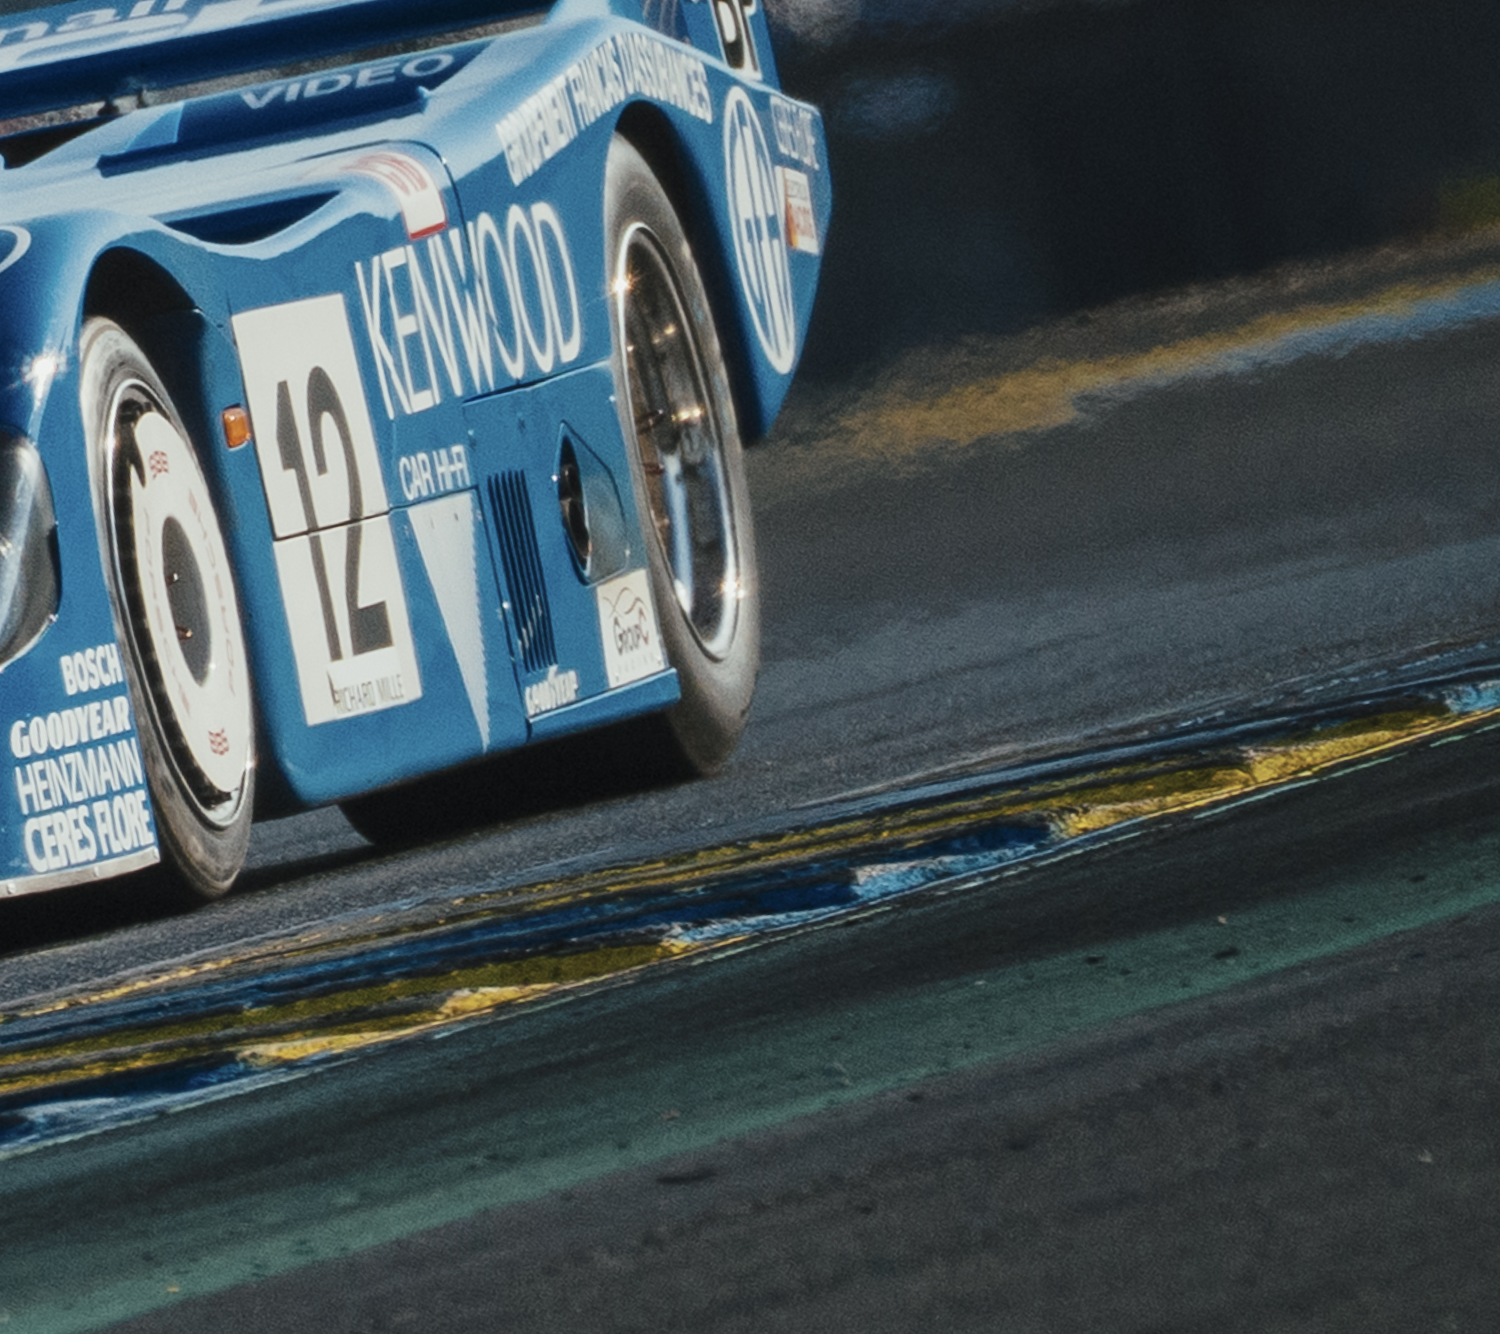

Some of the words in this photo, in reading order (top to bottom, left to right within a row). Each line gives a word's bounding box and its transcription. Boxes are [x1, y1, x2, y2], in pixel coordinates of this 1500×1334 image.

[239, 53, 455, 111] VIDEO
[355, 200, 583, 420] KENWOOD
[400, 453, 434, 501] CAR
[275, 366, 394, 661] 12
[60, 643, 124, 696] BOSCH
[10, 696, 131, 759] GOODYEAR
[15, 737, 143, 816] HEINZMANN
[25, 804, 97, 873] CERES
[93, 789, 154, 856] FLORE
